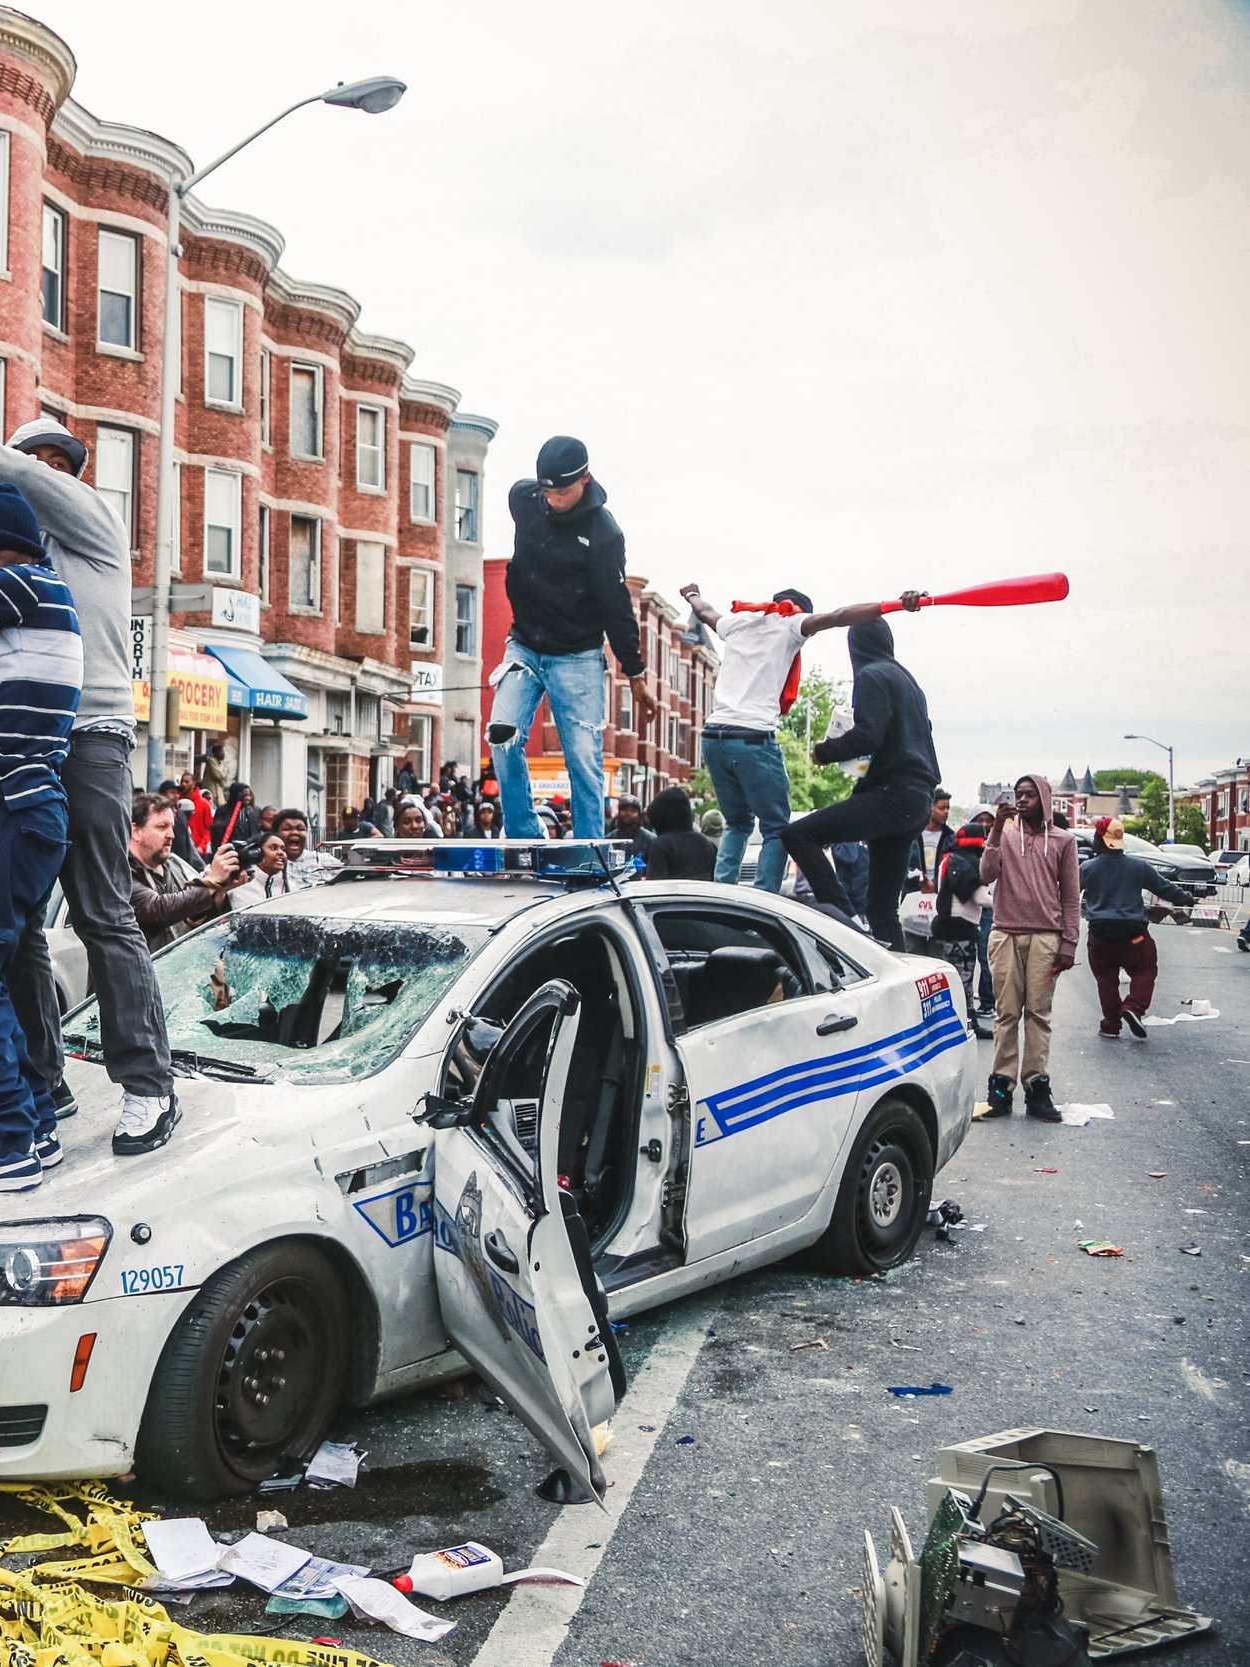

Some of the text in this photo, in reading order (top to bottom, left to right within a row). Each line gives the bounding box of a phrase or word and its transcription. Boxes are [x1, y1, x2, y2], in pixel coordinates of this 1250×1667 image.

[255, 692, 282, 707] HAIR
[917, 979, 930, 999] 911
[696, 1117, 706, 1142] E
[121, 1265, 184, 1294] 129057
